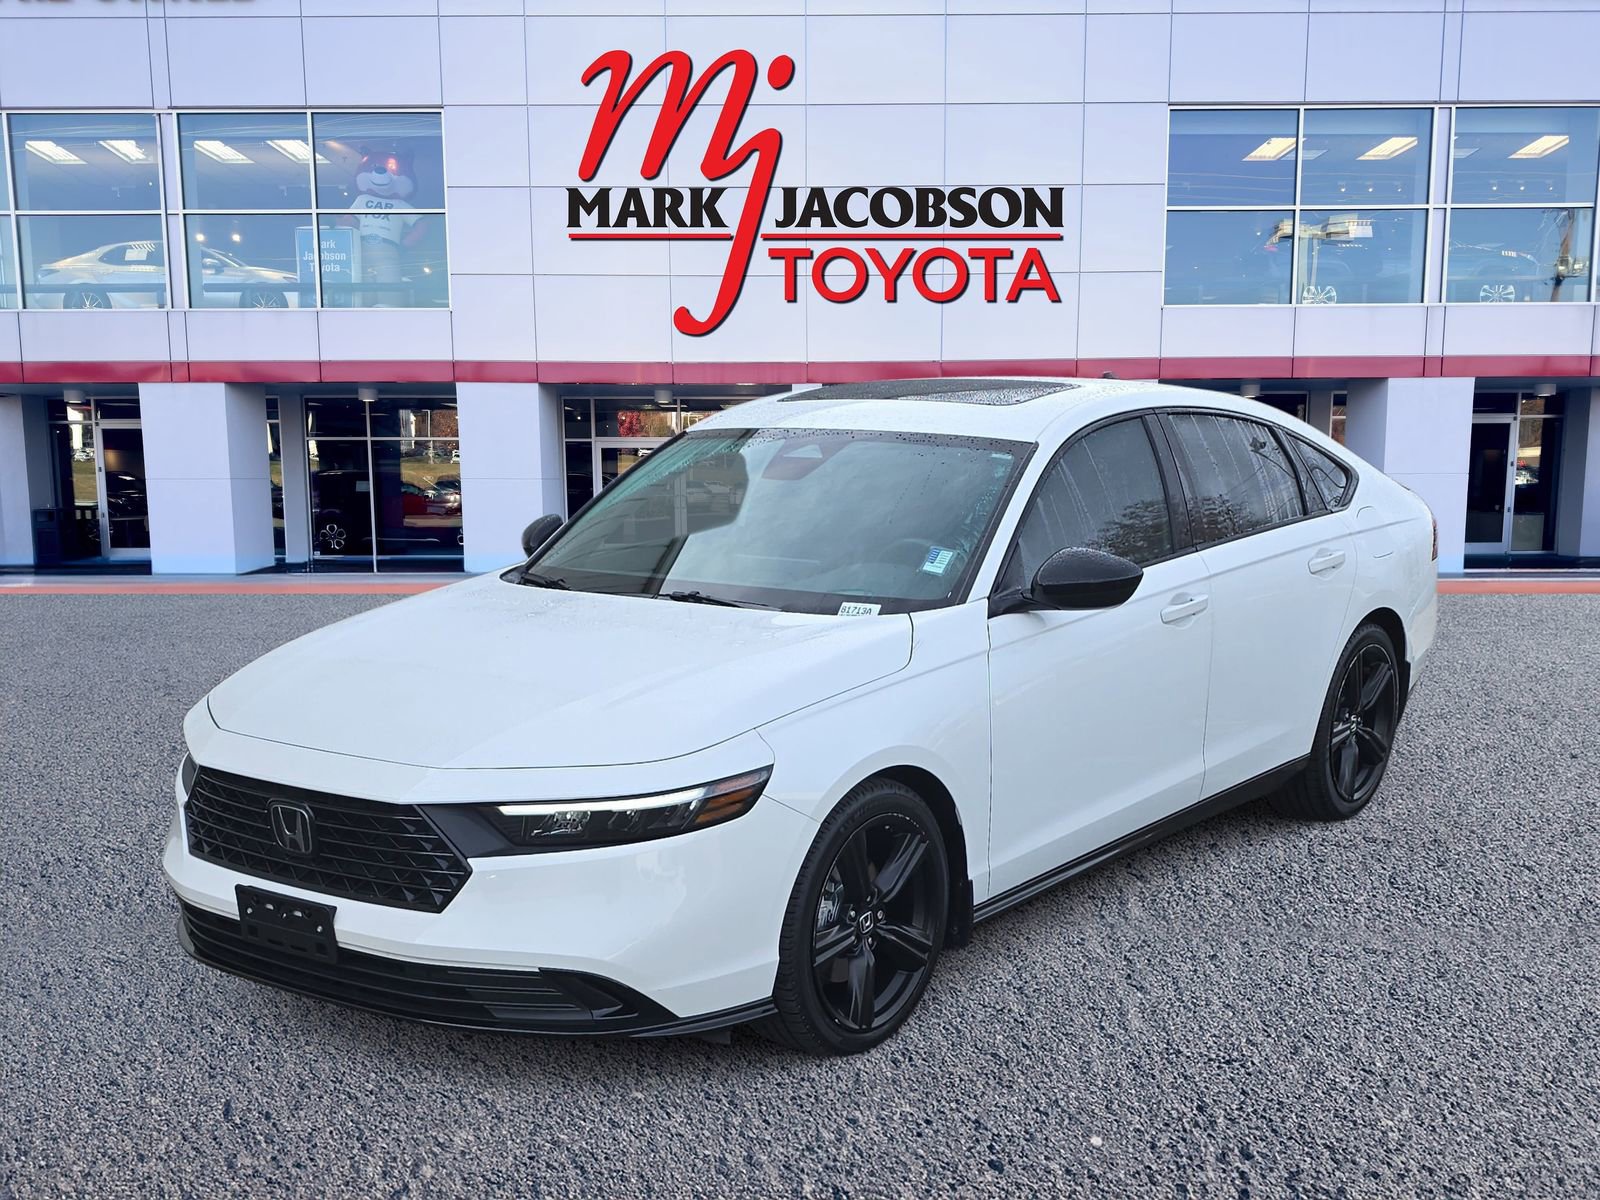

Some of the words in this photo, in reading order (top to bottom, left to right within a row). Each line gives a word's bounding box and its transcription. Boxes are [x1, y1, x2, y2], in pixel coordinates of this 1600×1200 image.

[566, 187, 729, 228] MARK
[774, 187, 1065, 228] JACOBSON
[316, 239, 336, 249] ark
[768, 247, 1063, 304] TOYOTA
